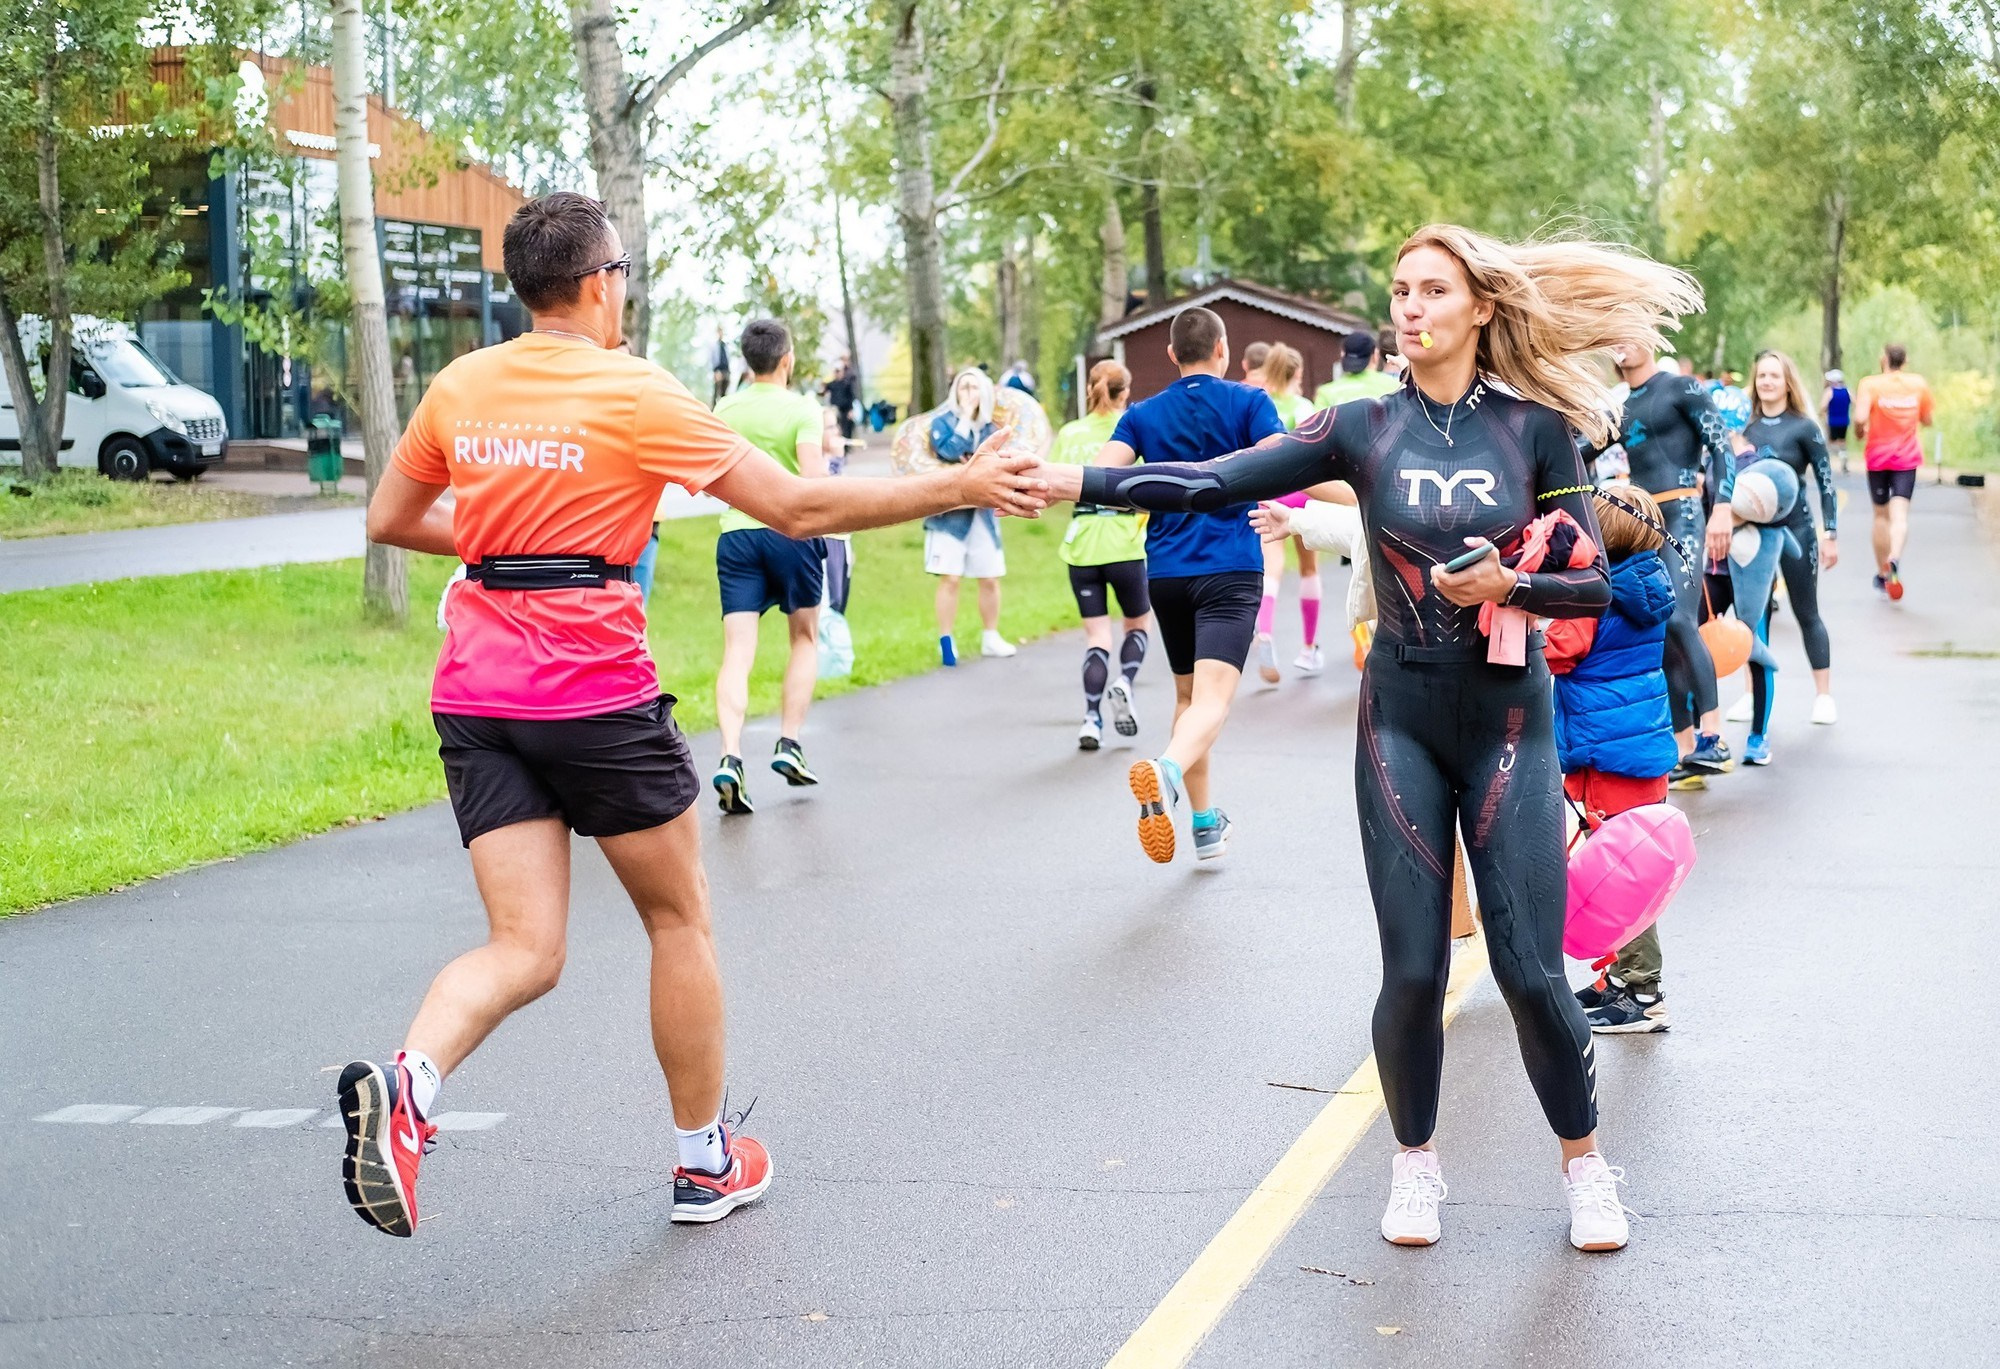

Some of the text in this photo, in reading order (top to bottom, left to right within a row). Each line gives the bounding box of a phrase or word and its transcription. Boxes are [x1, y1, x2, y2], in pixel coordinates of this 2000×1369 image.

[1466, 384, 1486, 410] TYR
[454, 435, 585, 473] RUNNER
[1400, 469, 1498, 506] TYR
[1597, 487, 1678, 547] TYR TYR TYR
[1473, 707, 1524, 848] HURRICANE
